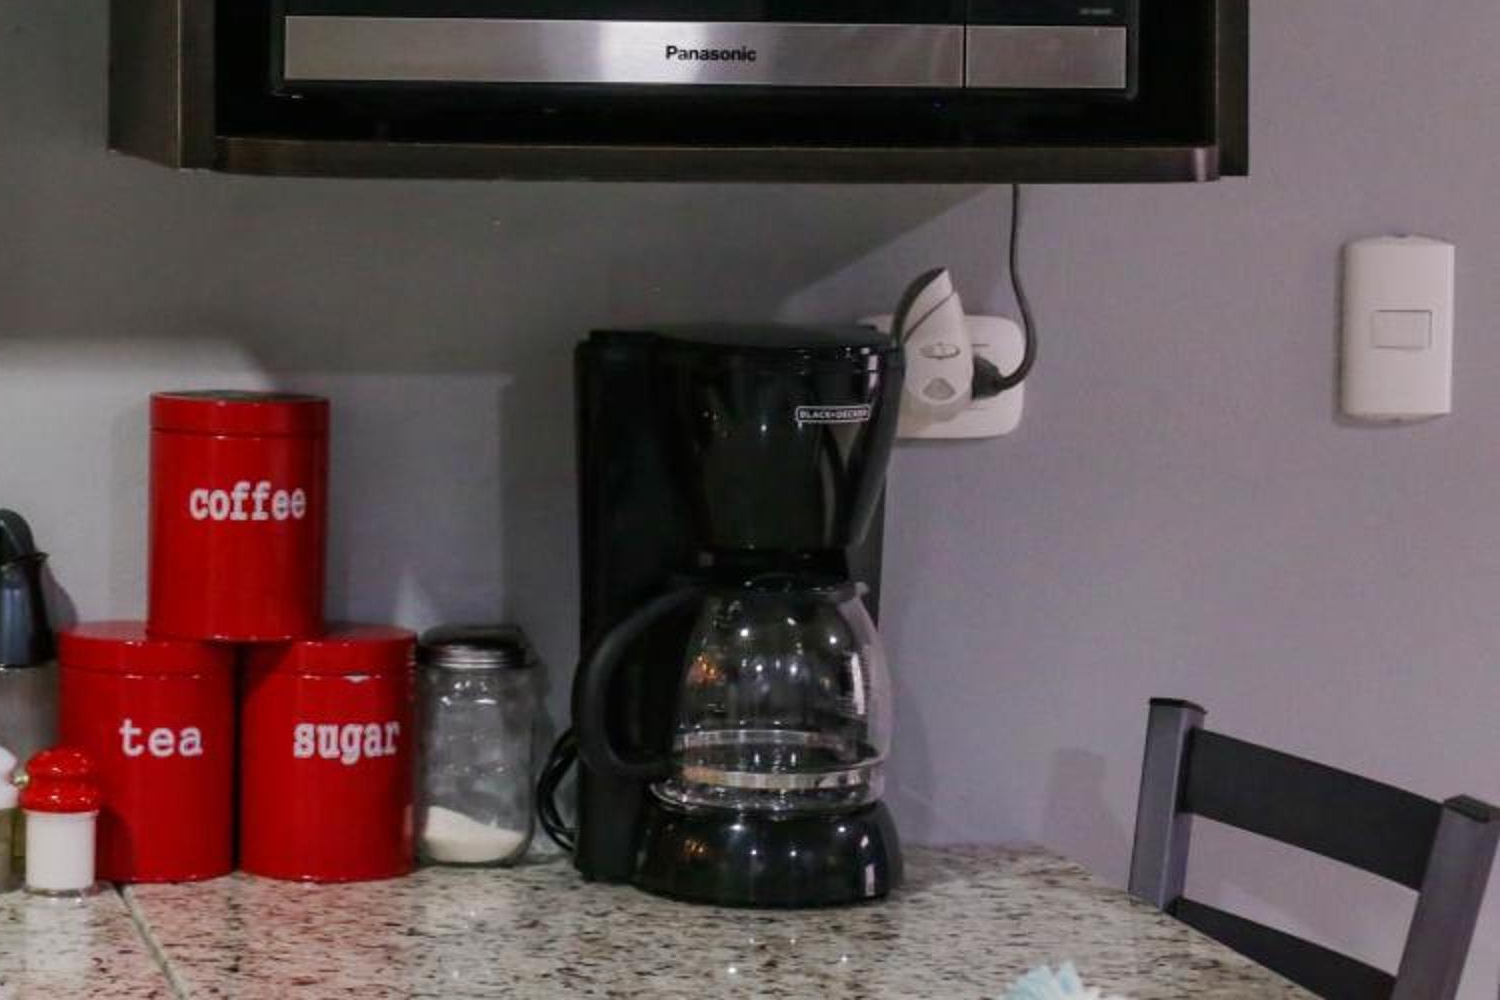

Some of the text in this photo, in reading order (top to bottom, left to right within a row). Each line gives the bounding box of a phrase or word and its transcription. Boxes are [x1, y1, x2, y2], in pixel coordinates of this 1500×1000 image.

[665, 45, 757, 62] Panasonic
[189, 481, 307, 521] coffee
[119, 718, 203, 758] tea
[293, 720, 400, 766] sugar
